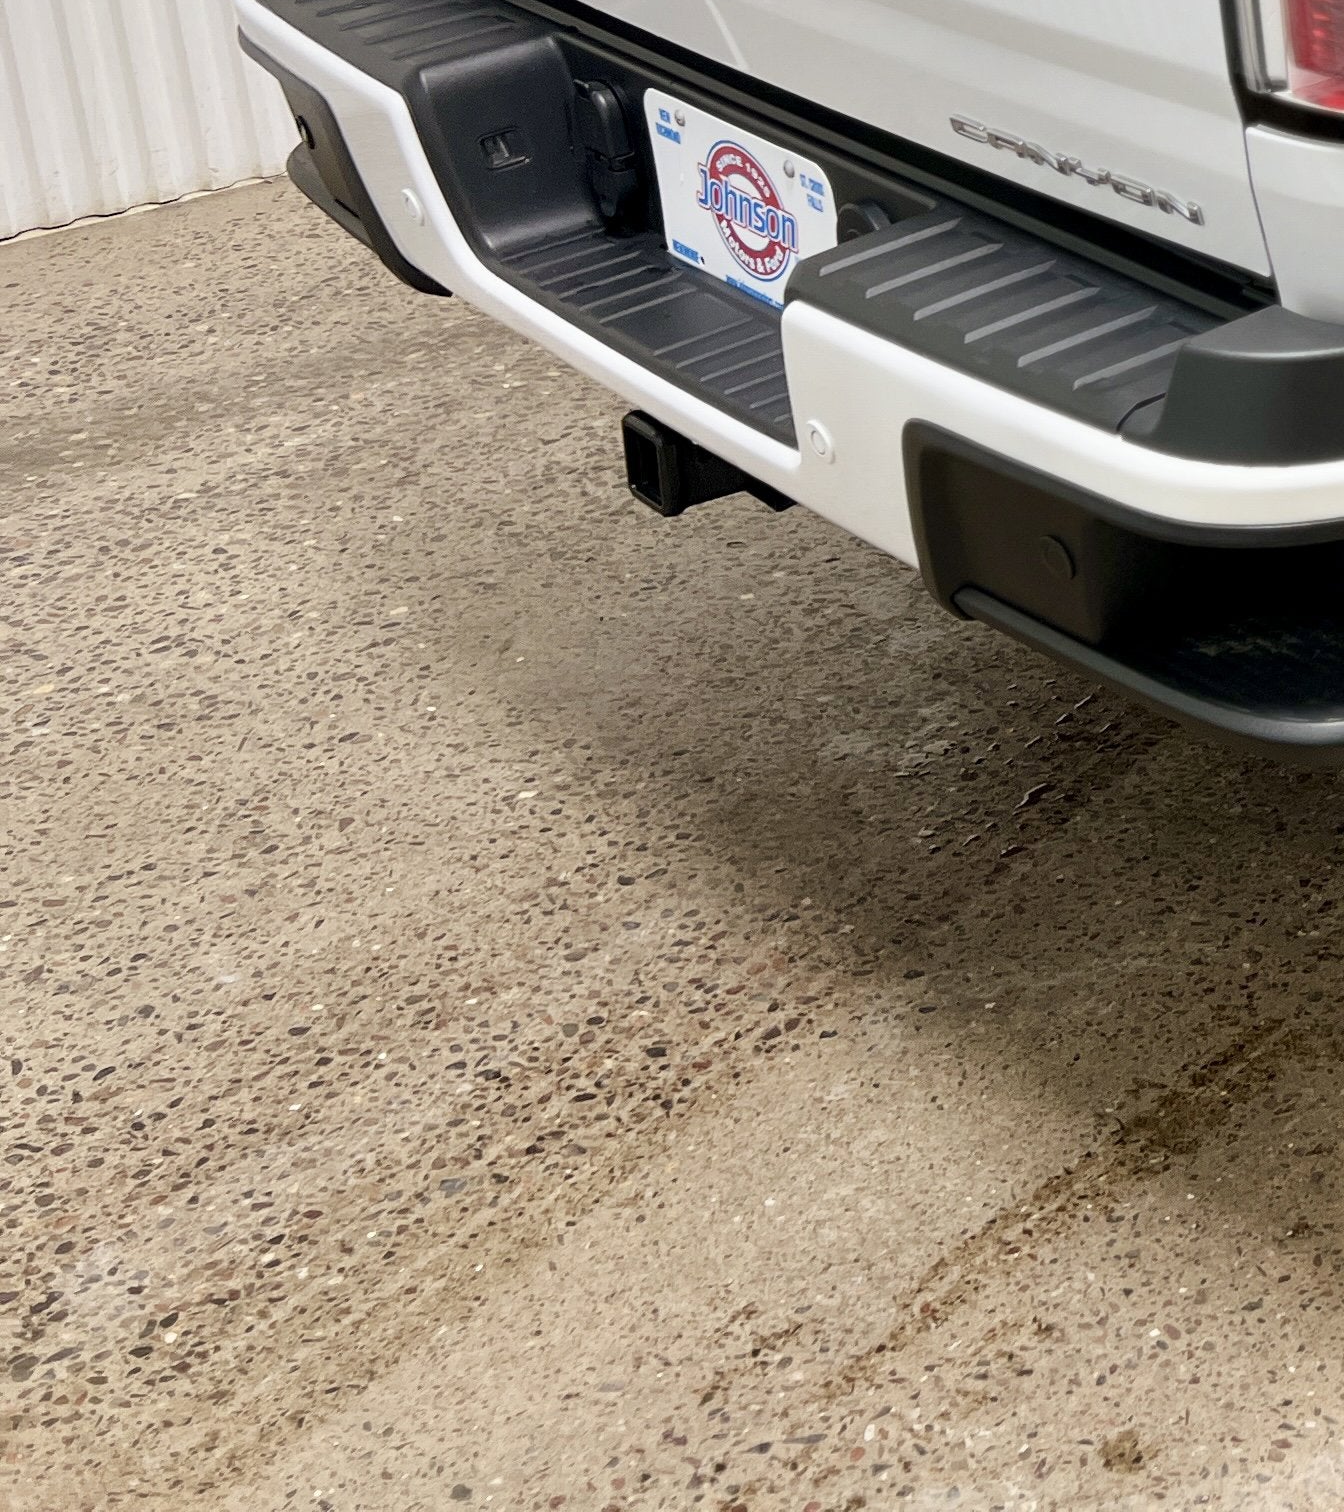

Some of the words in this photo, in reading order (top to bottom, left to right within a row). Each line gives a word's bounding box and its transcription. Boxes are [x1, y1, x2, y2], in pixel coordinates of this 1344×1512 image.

[716, 153, 743, 172] SINCE
[949, 113, 1205, 226] CANYON
[697, 163, 798, 253] Johnson
[720, 219, 756, 270] Motors
